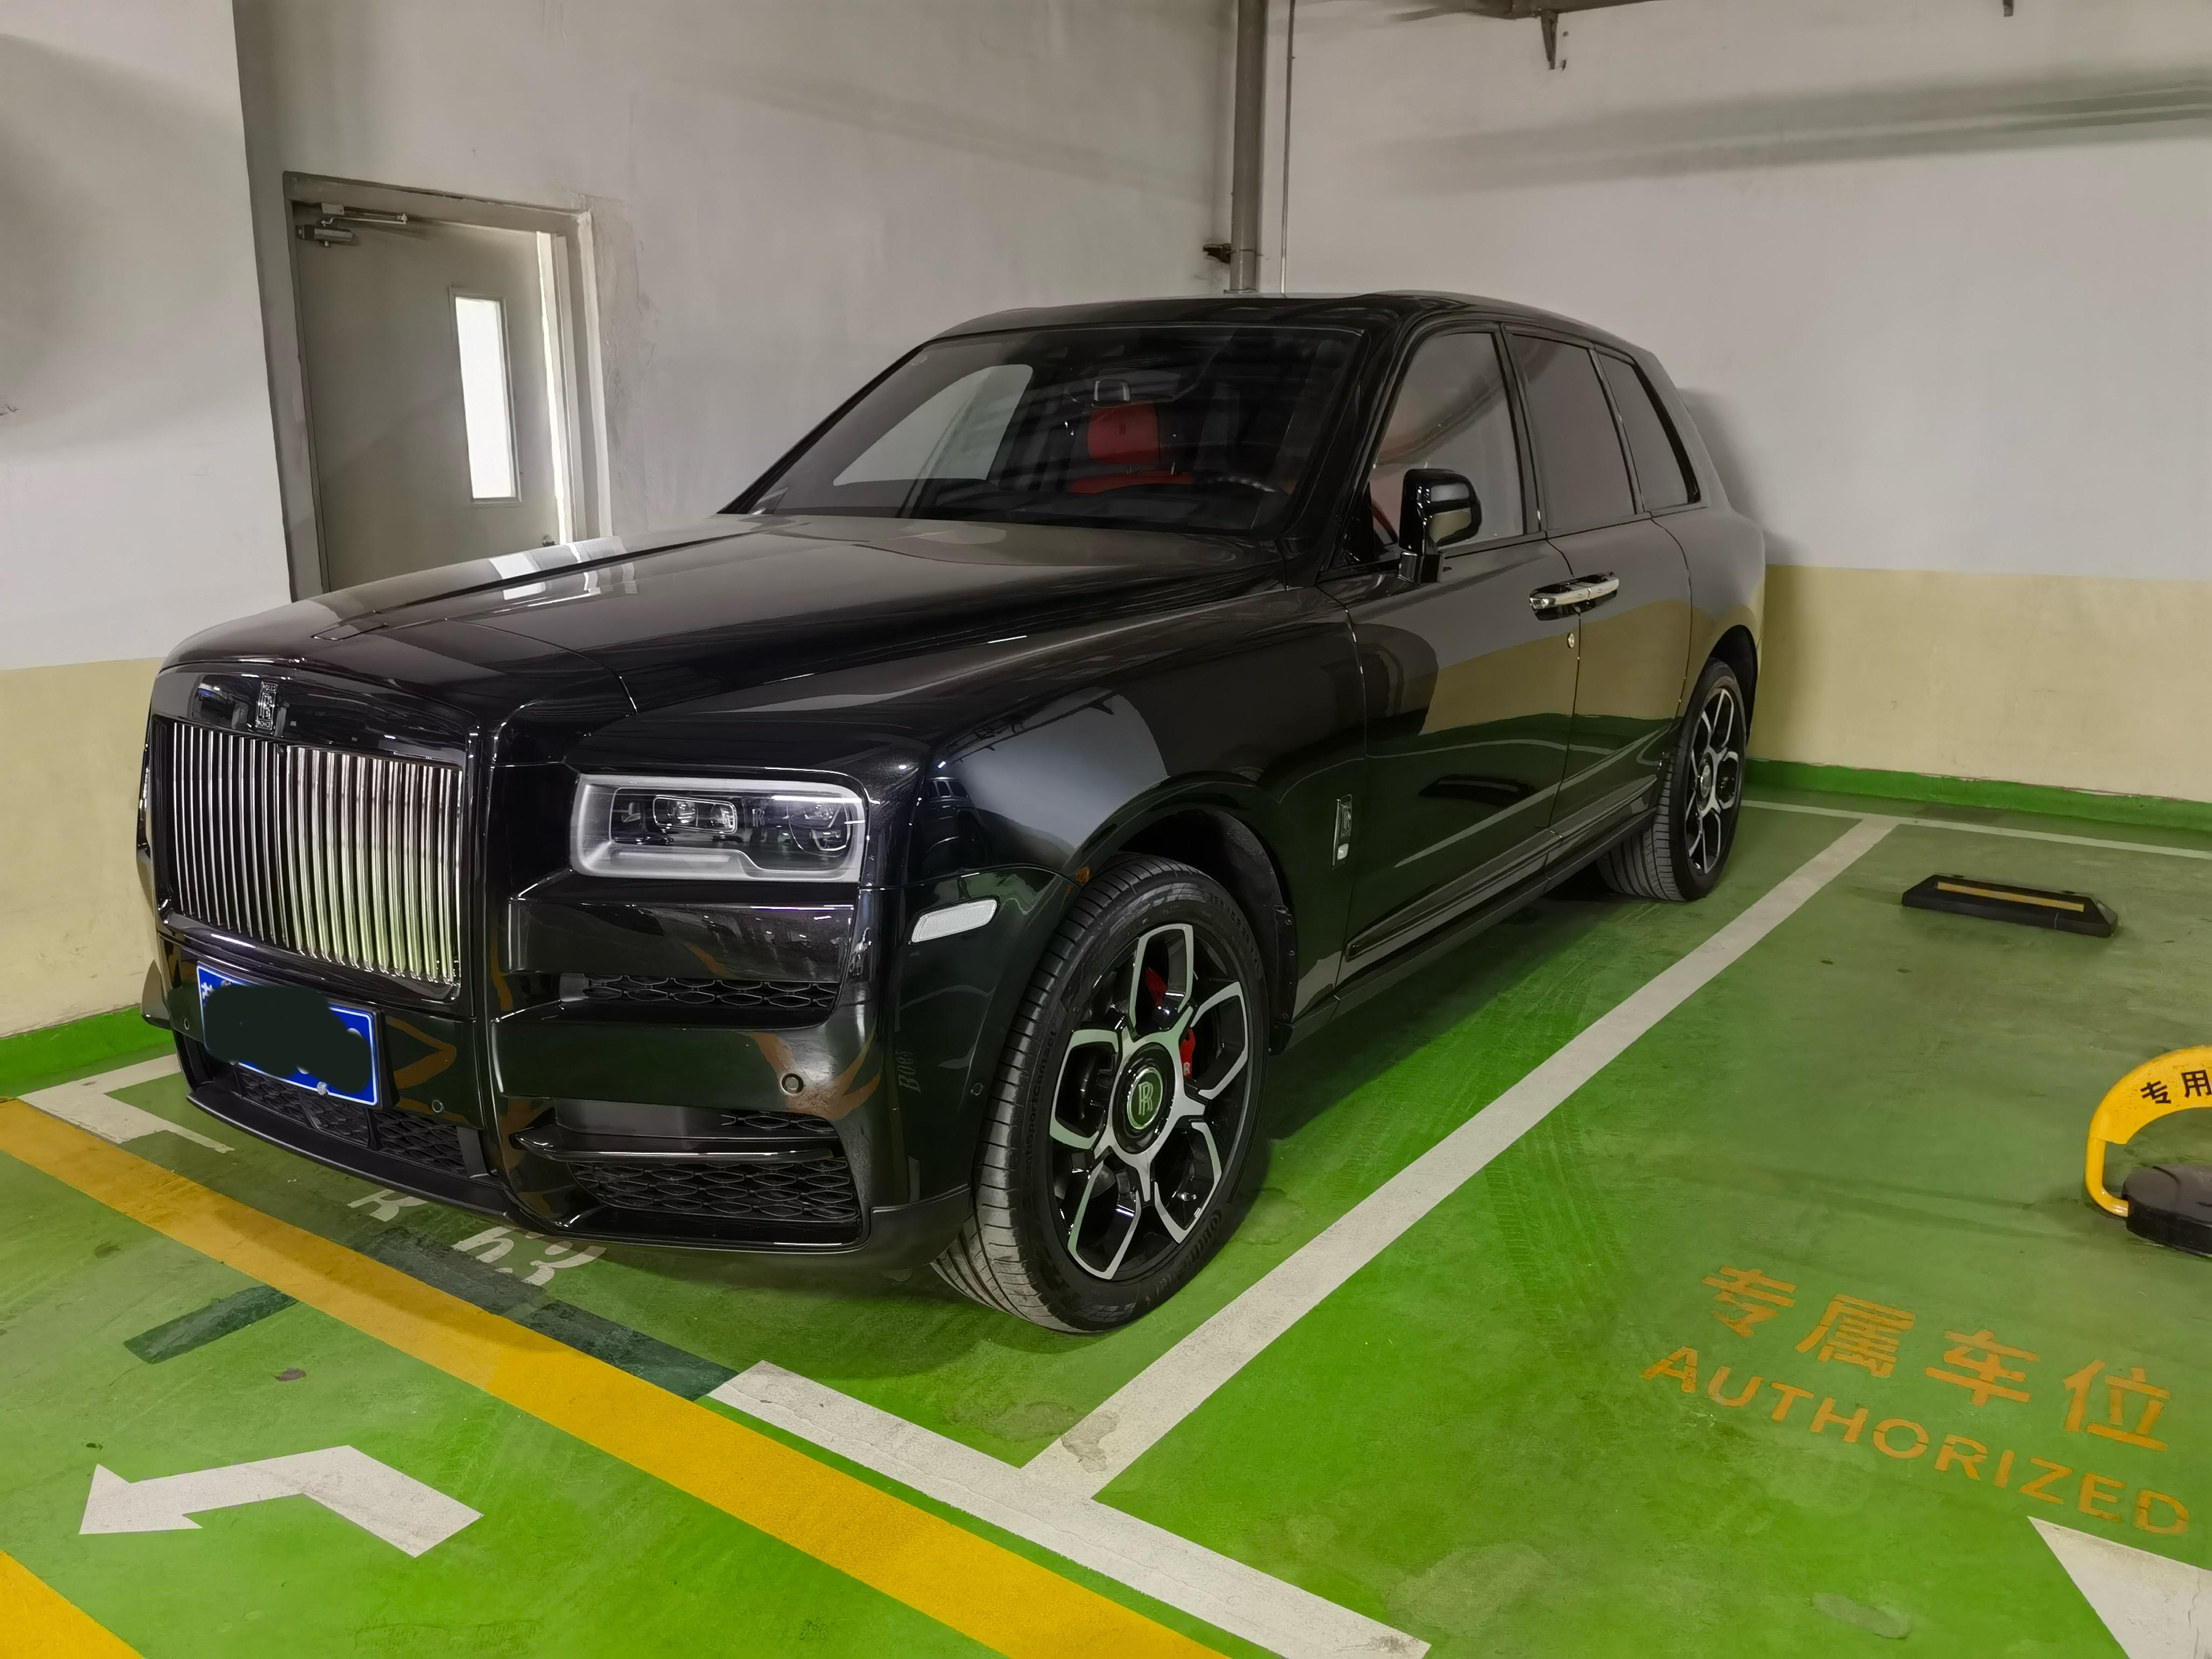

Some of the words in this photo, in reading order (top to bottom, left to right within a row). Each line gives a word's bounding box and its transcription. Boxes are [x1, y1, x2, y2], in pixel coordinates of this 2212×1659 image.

[1138, 1081, 1154, 1116] RR
[2140, 1070, 2212, 1104] 专用
[1702, 1264, 2171, 1451] 专属车位
[1641, 1346, 2189, 1535] AUTHORIZED
